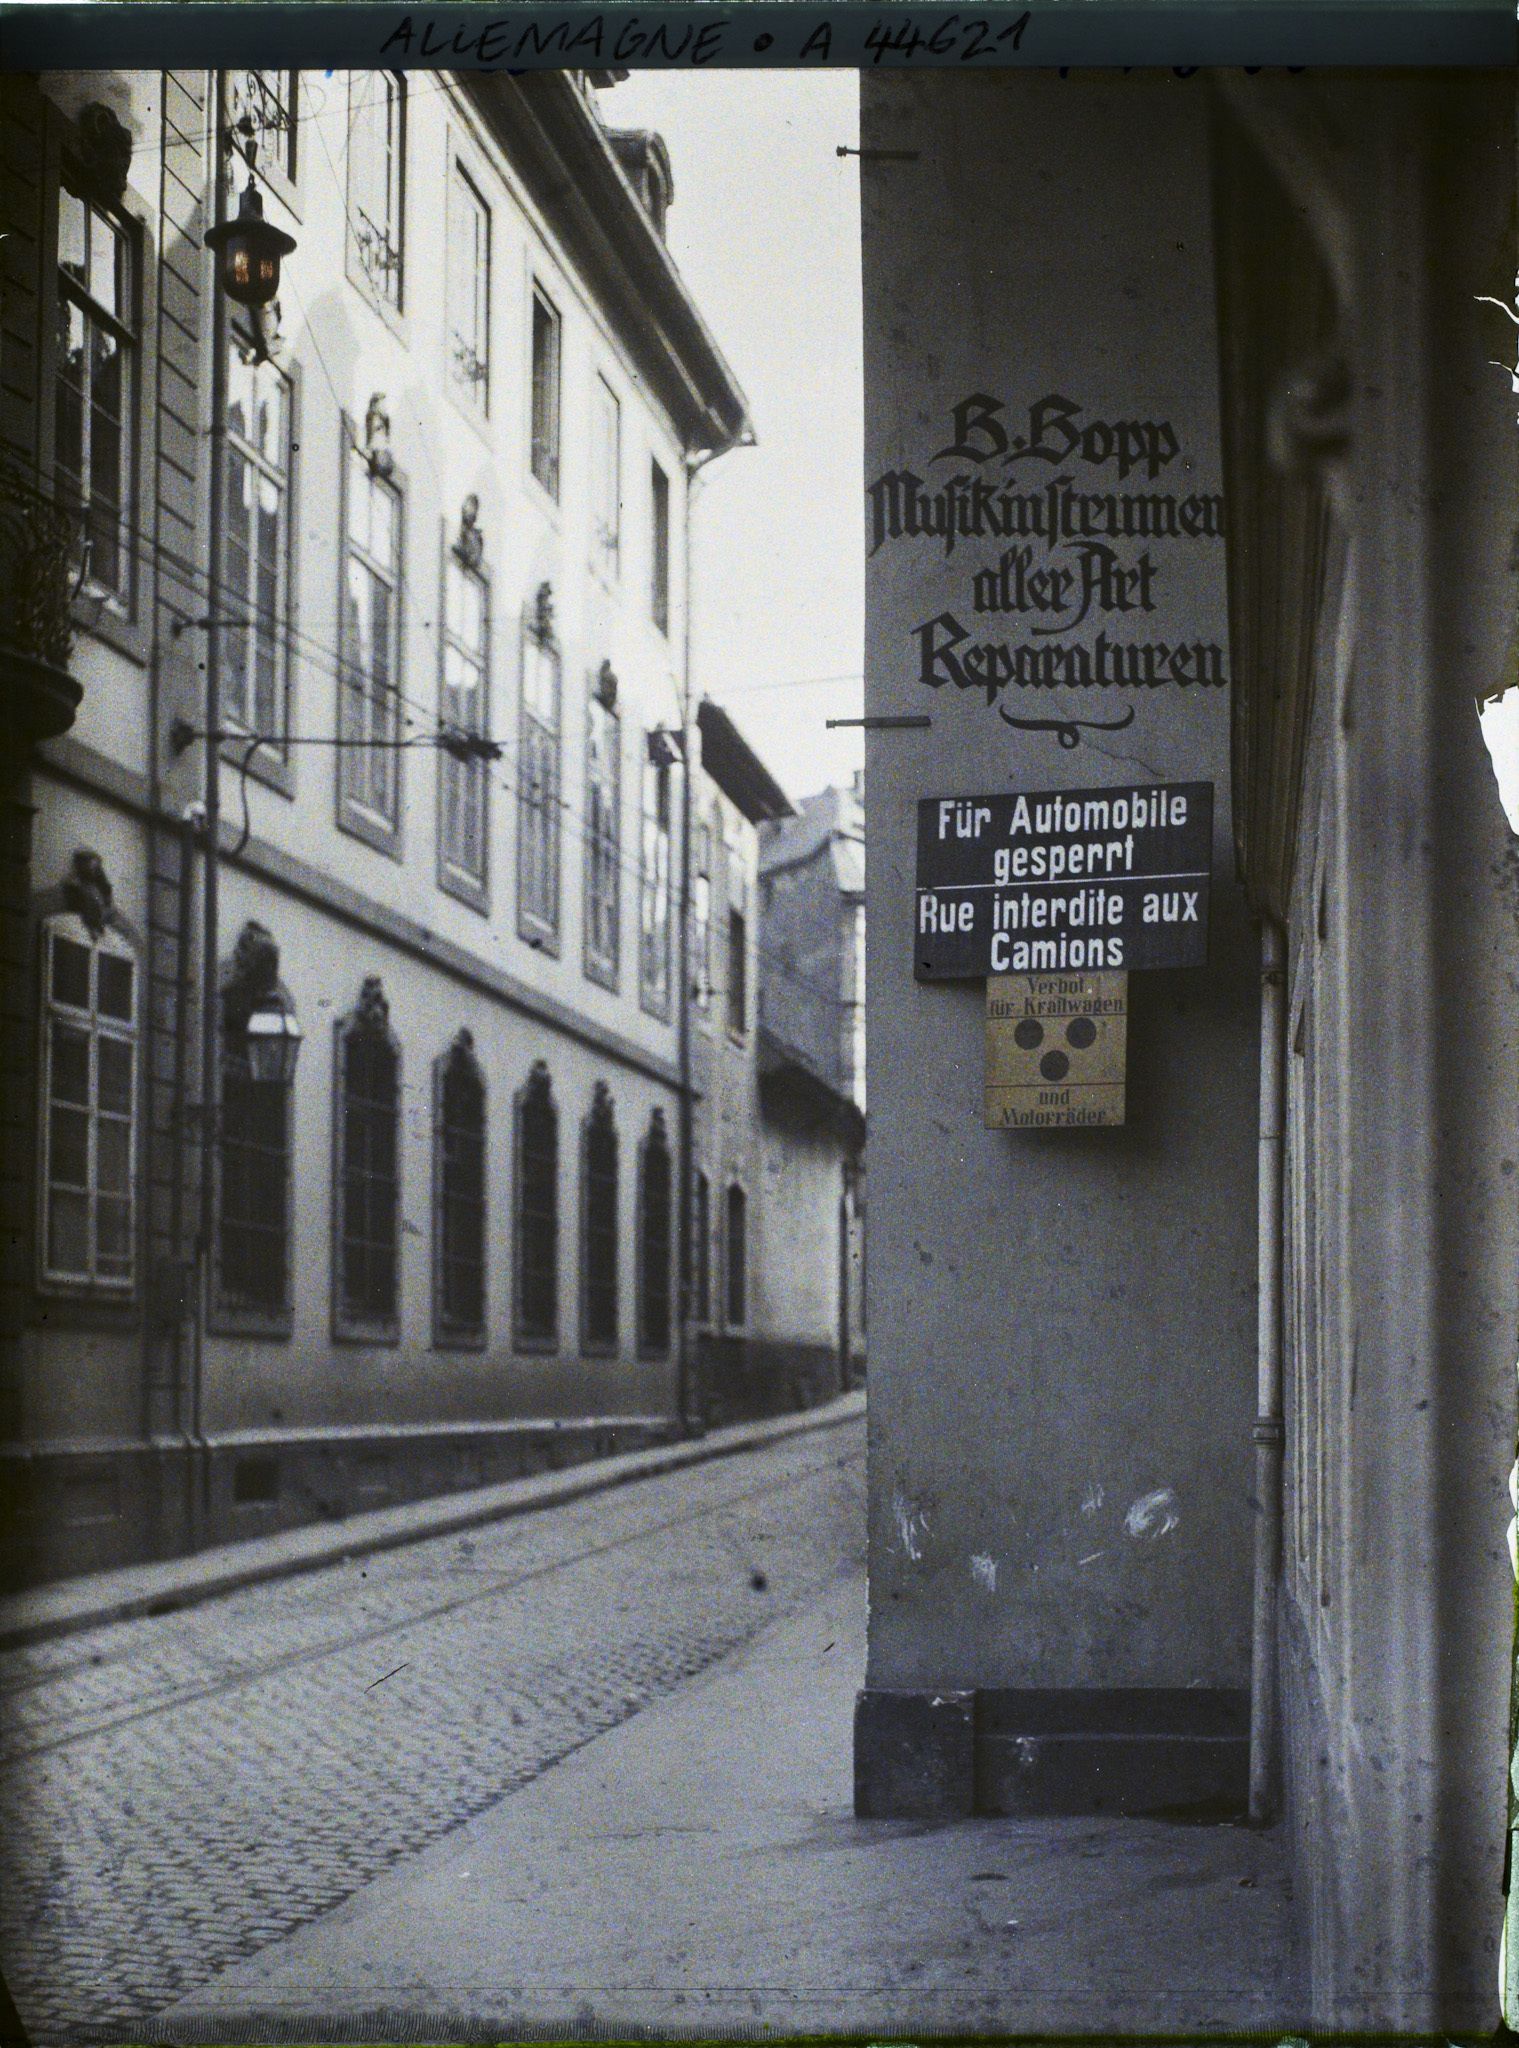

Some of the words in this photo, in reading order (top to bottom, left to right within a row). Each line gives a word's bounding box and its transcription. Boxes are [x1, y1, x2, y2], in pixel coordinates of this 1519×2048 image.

[380, 15, 729, 66] ALLEMAGNE
[799, 21, 832, 61] A
[863, 10, 1032, 64] 44621
[971, 544, 1075, 613] aller
[1030, 541, 1158, 636] Art
[910, 611, 1228, 707] Reparaturen
[937, 799, 991, 840] Für
[1009, 790, 1188, 836] Automobile
[993, 834, 1134, 887] gesperrt
[919, 894, 975, 934] Rue
[992, 888, 1124, 931] interdite
[1142, 890, 1199, 924] aux
[990, 931, 1124, 972] Camions
[1027, 976, 1084, 995] Verbot
[1039, 1088, 1071, 1105] und
